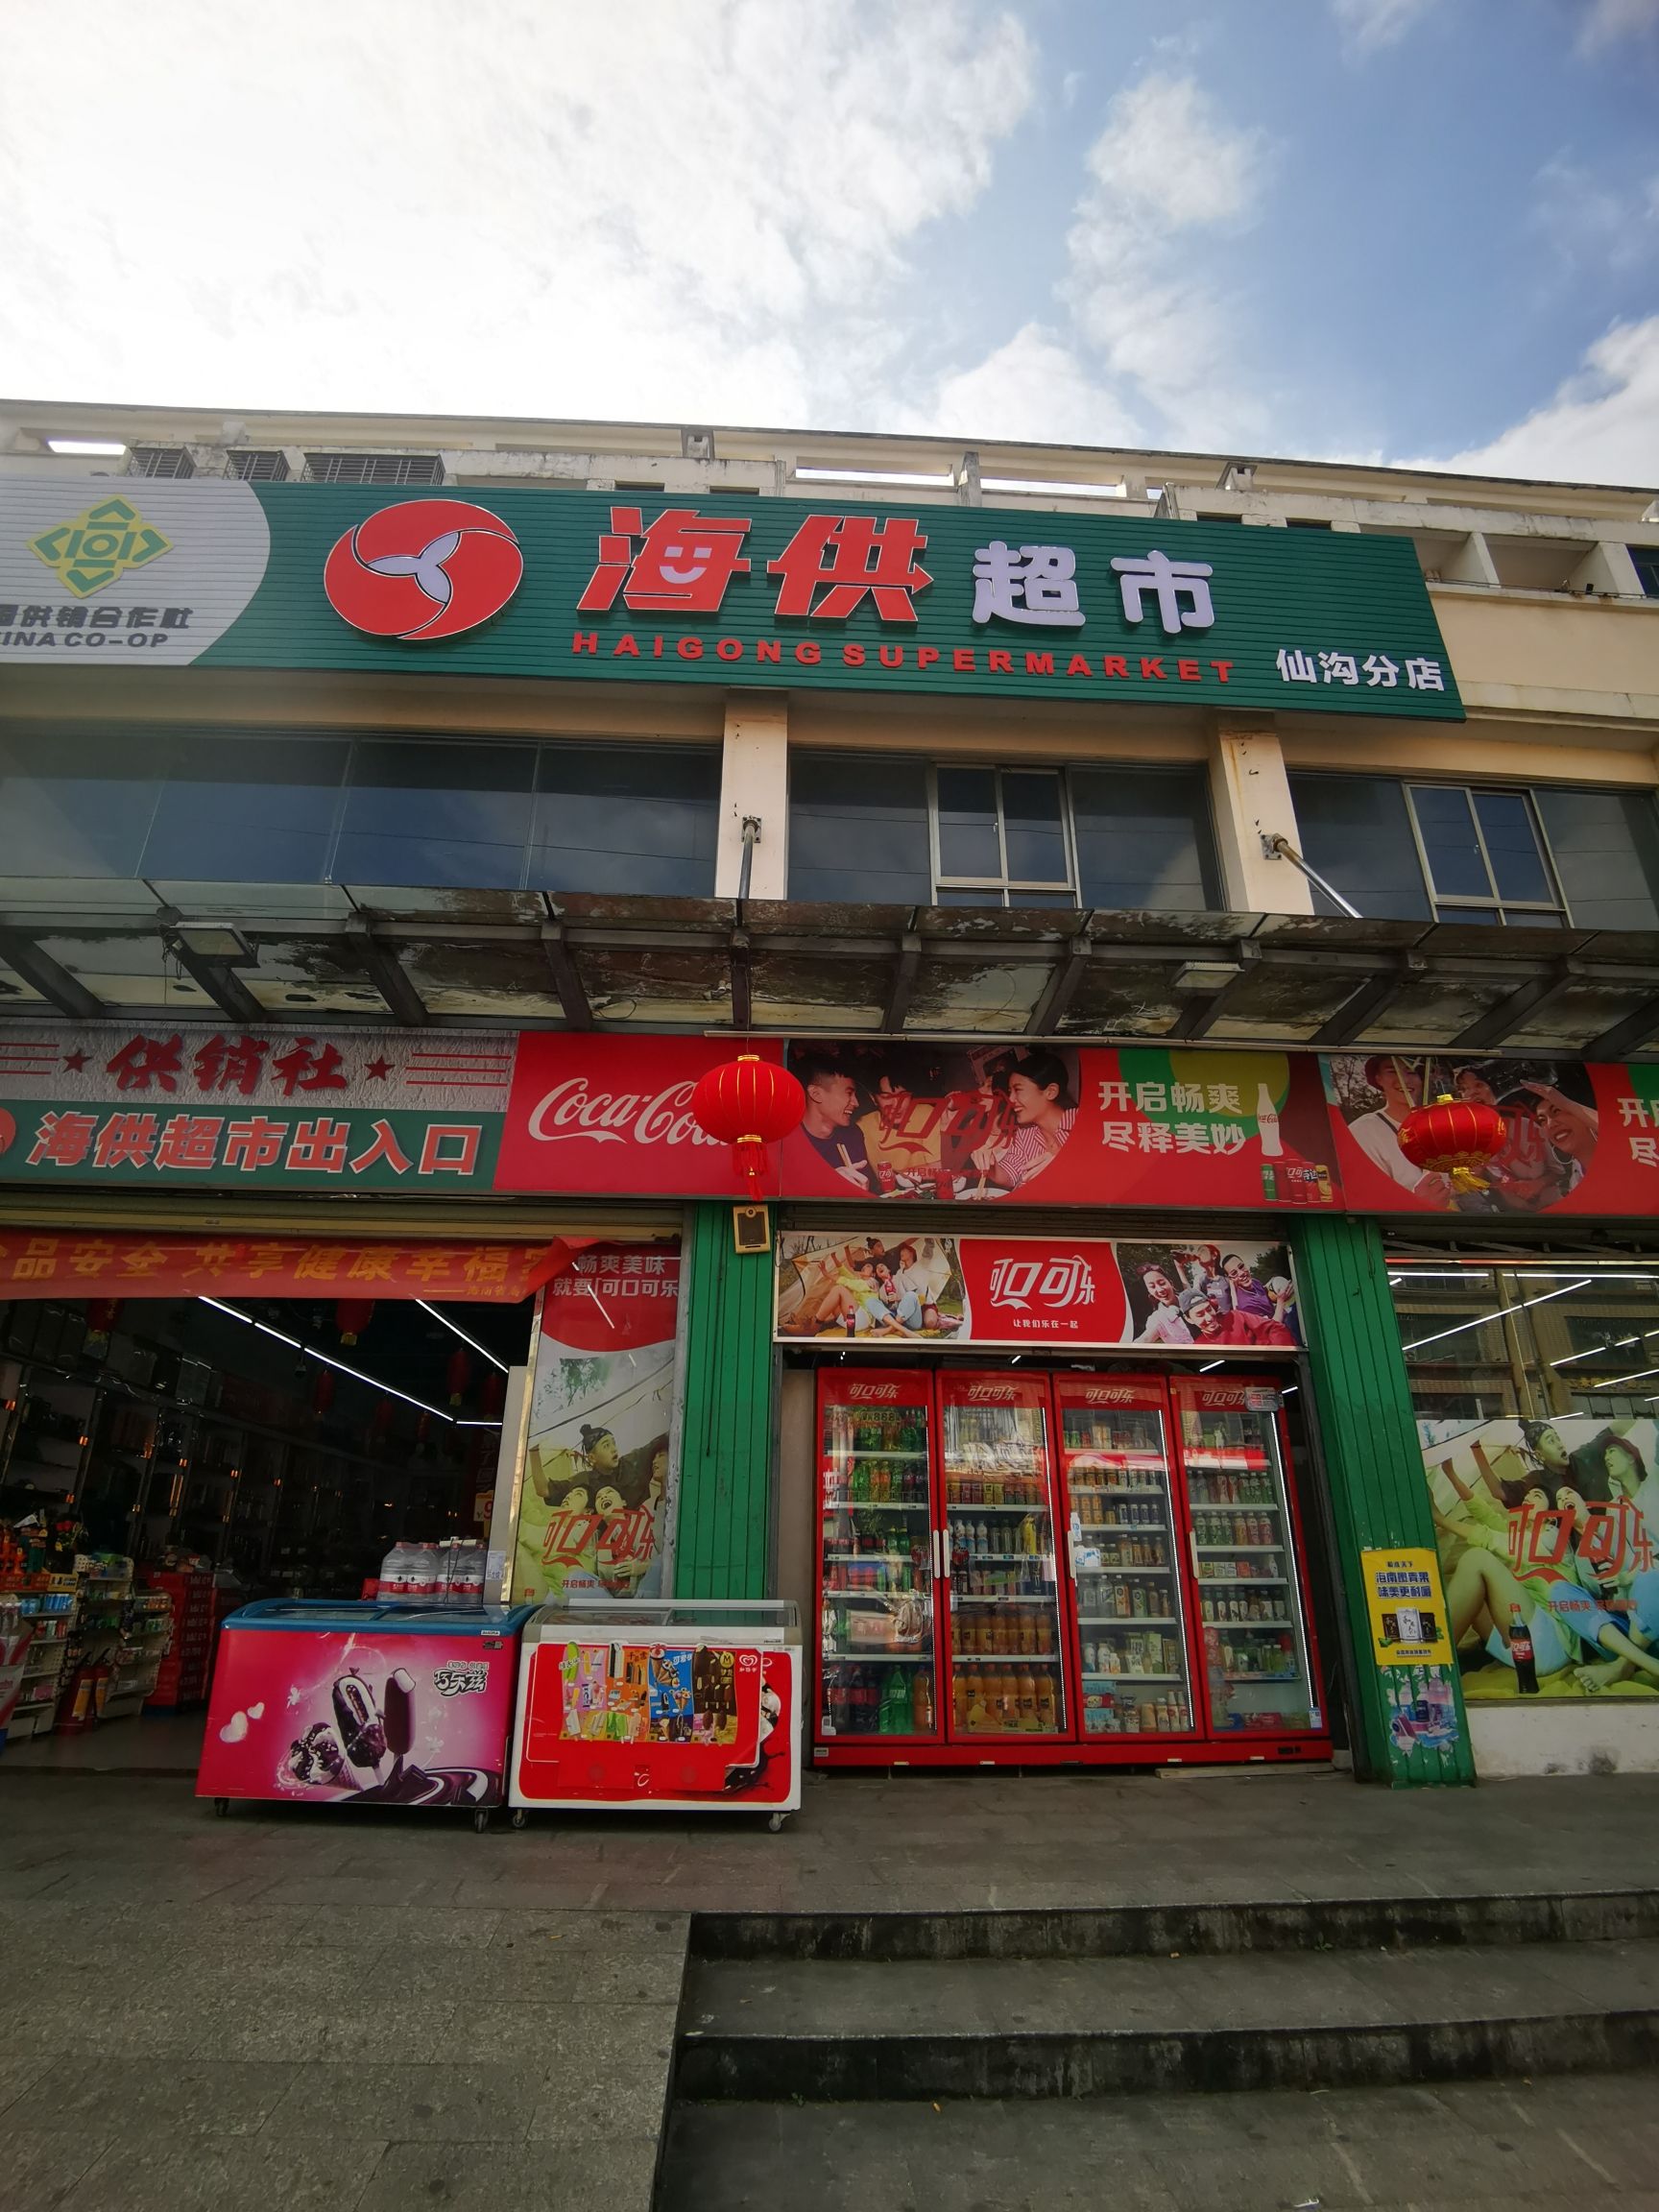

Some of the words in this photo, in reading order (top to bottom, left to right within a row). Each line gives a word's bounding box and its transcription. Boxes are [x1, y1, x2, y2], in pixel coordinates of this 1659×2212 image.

[63, 632, 169, 648] CO-OP
[572, 632, 822, 664] HAIGONG
[842, 646, 1235, 685] SUPERMARKET
[1275, 648, 1445, 692] 仙沟分店
[106, 1033, 349, 1097] 供销社
[1096, 1080, 1242, 1115] 开启畅爽
[1617, 1096, 1659, 1129] 开
[25, 1110, 484, 1177] 海供超市出入口
[1100, 1120, 1246, 1156] 尽释美妙
[0, 1237, 169, 1280] 品安全
[989, 1254, 1096, 1311] 可口可乐
[1013, 1319, 1079, 1330] 让我们乐在一起
[849, 1382, 902, 1400] 可口可乐
[967, 1383, 1020, 1402] 可口可乐
[1085, 1388, 1135, 1405] 可口可乐
[1508, 1496, 1655, 1583] 可口可乐
[433, 1669, 488, 1696] 巧乐兹
